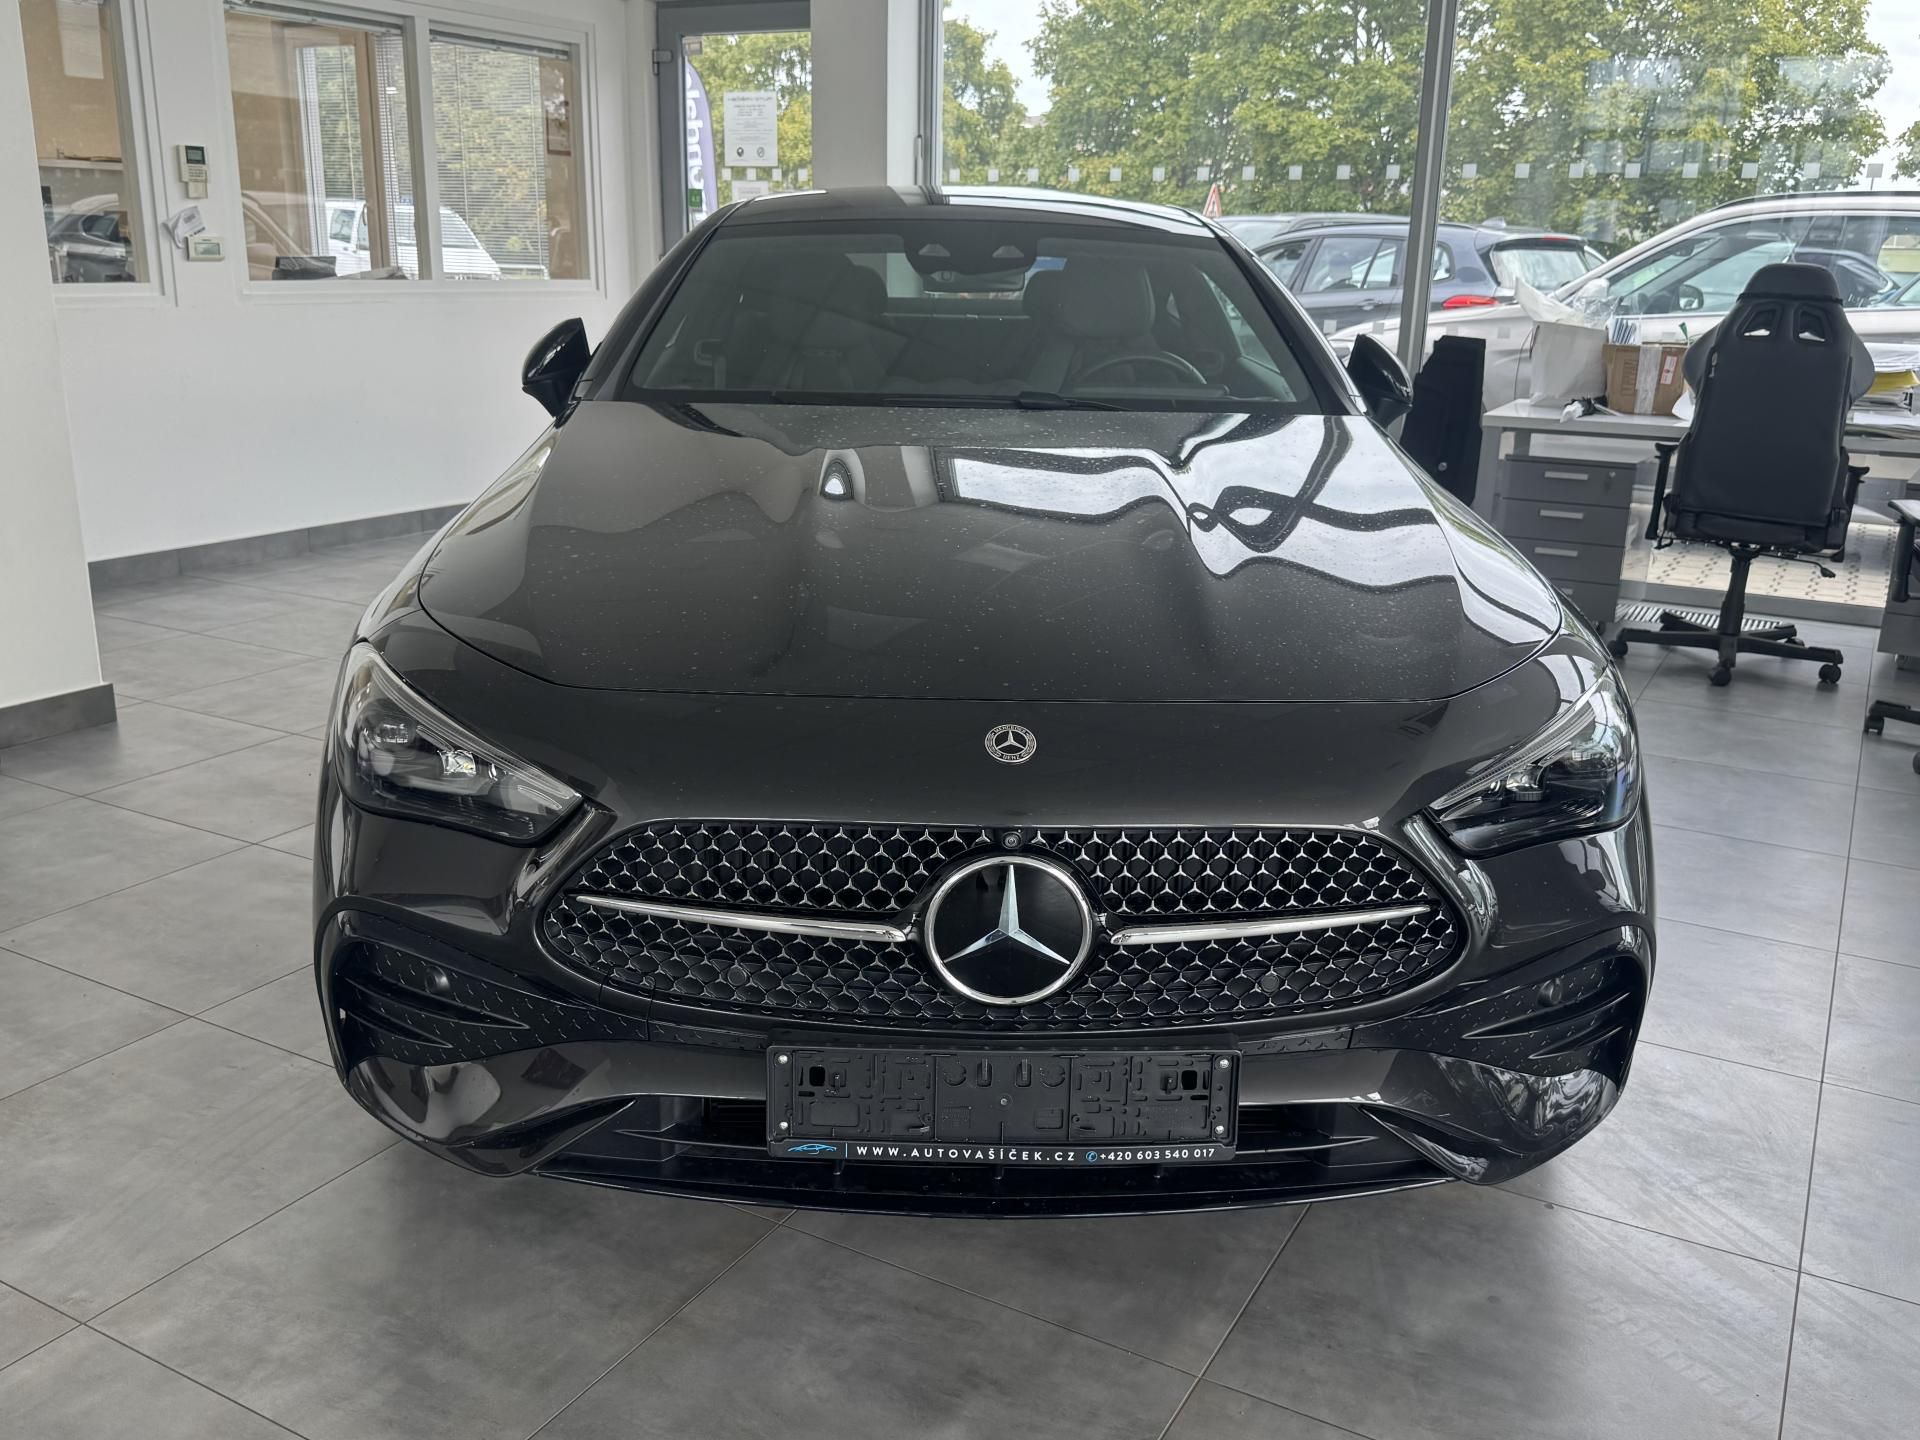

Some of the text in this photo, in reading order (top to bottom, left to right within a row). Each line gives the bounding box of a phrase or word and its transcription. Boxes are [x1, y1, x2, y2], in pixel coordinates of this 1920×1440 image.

[856, 1146, 1215, 1161] WWW.AUTOVAŠÍČEK.CZ +420 603 540 017
